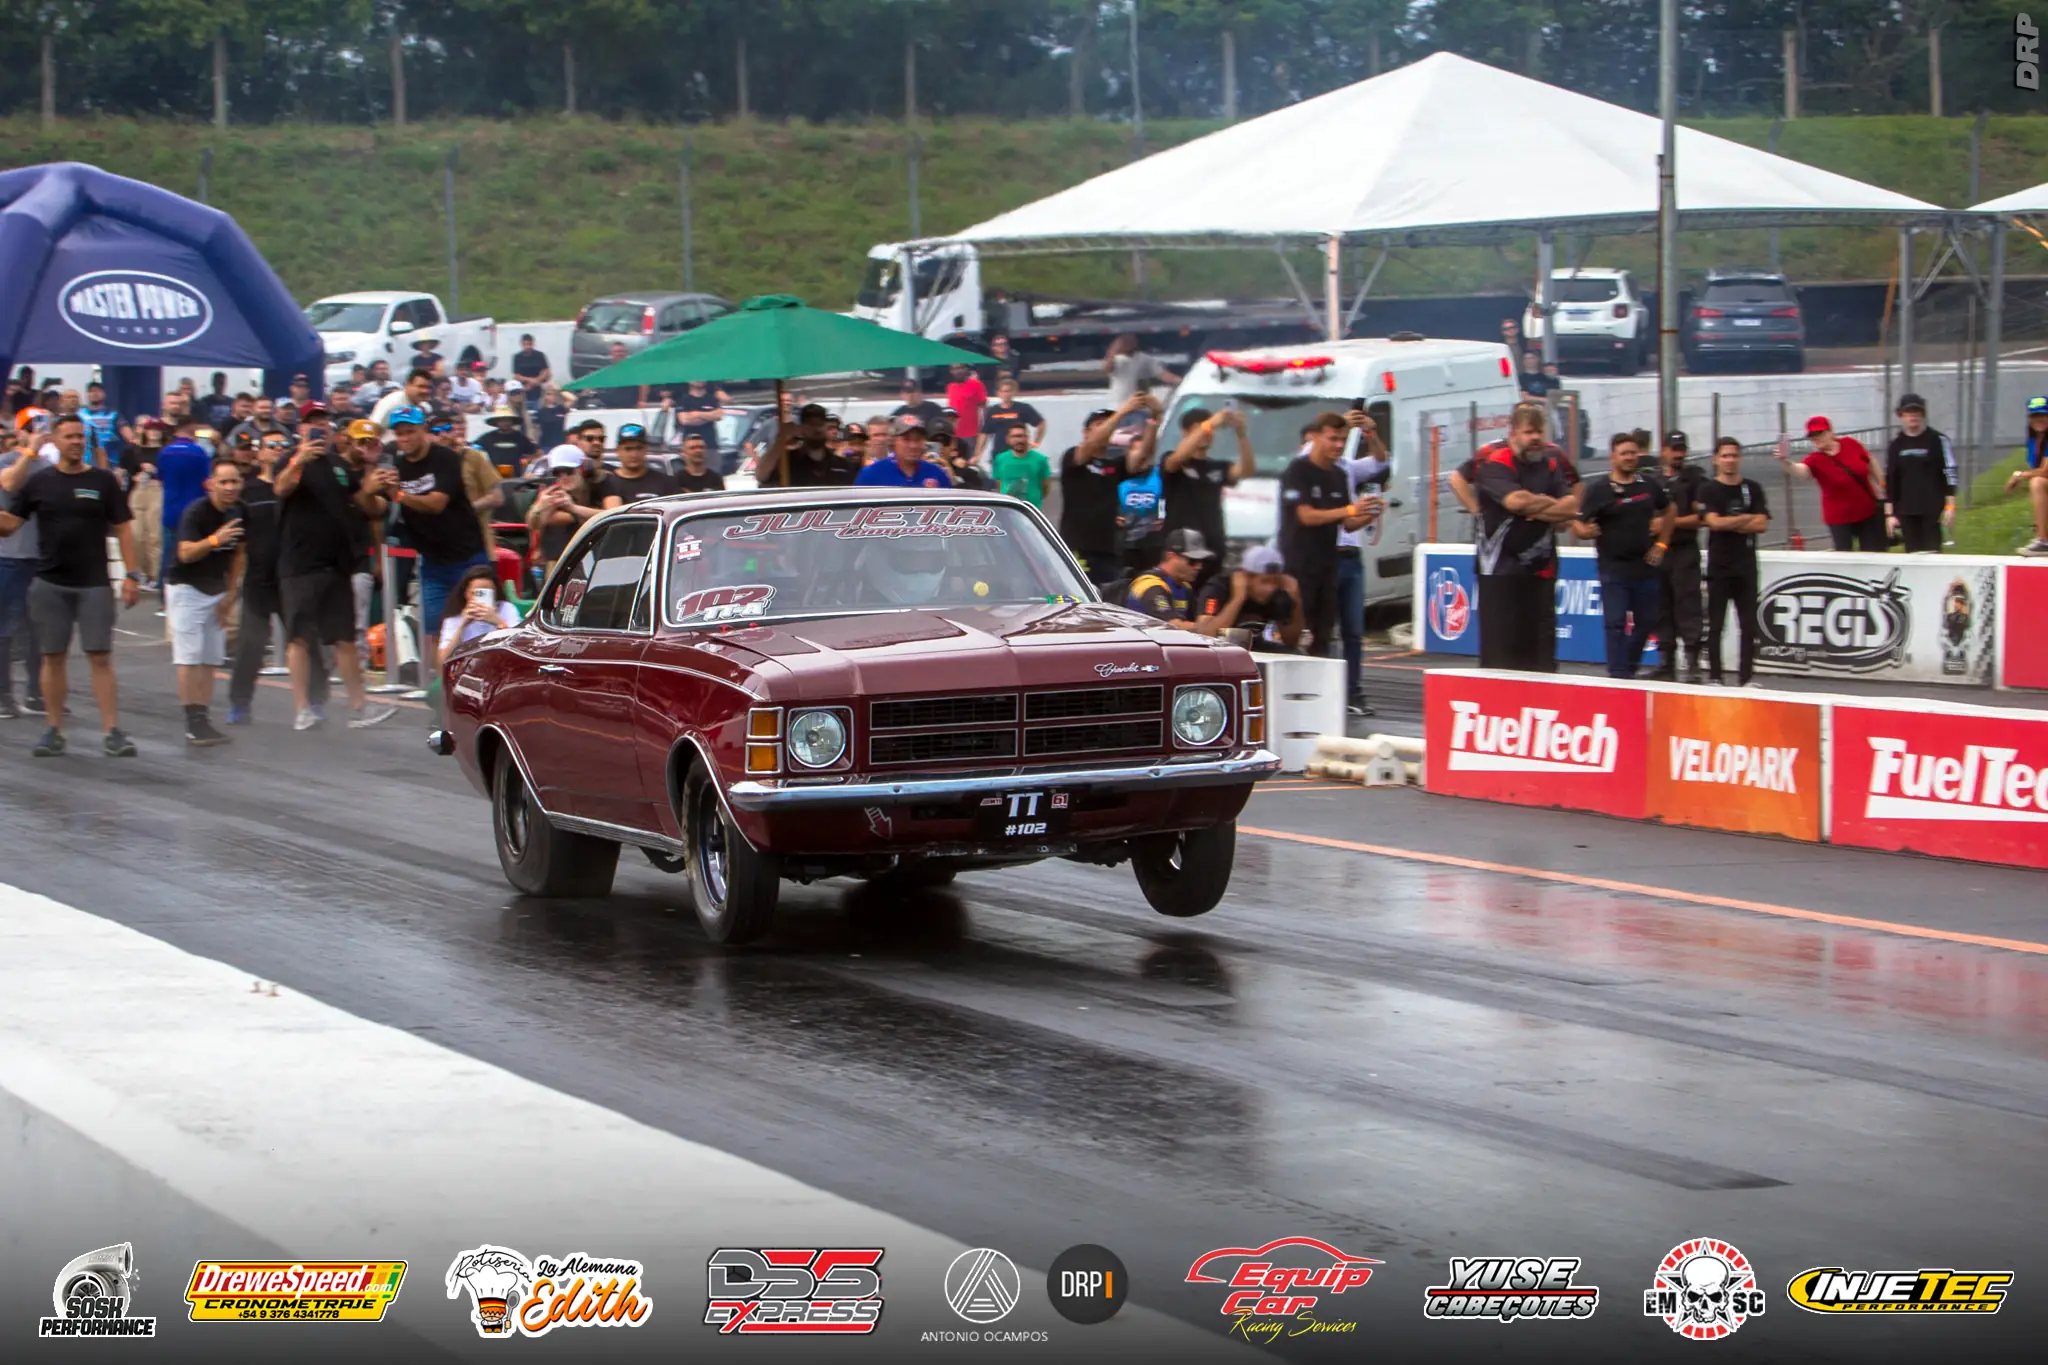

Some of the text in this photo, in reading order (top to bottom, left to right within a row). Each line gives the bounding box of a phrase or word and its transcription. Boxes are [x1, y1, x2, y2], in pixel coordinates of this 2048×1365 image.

[70, 282, 199, 319] MASTER POWER
[724, 506, 997, 540] JULIETA
[676, 585, 777, 621] 102
[1773, 595, 1889, 647] REGIS
[1449, 700, 1619, 768] FuelTech
[1669, 735, 1799, 794] VELOPARK
[1007, 792, 1044, 817] TT
[1005, 822, 1047, 836] #102
